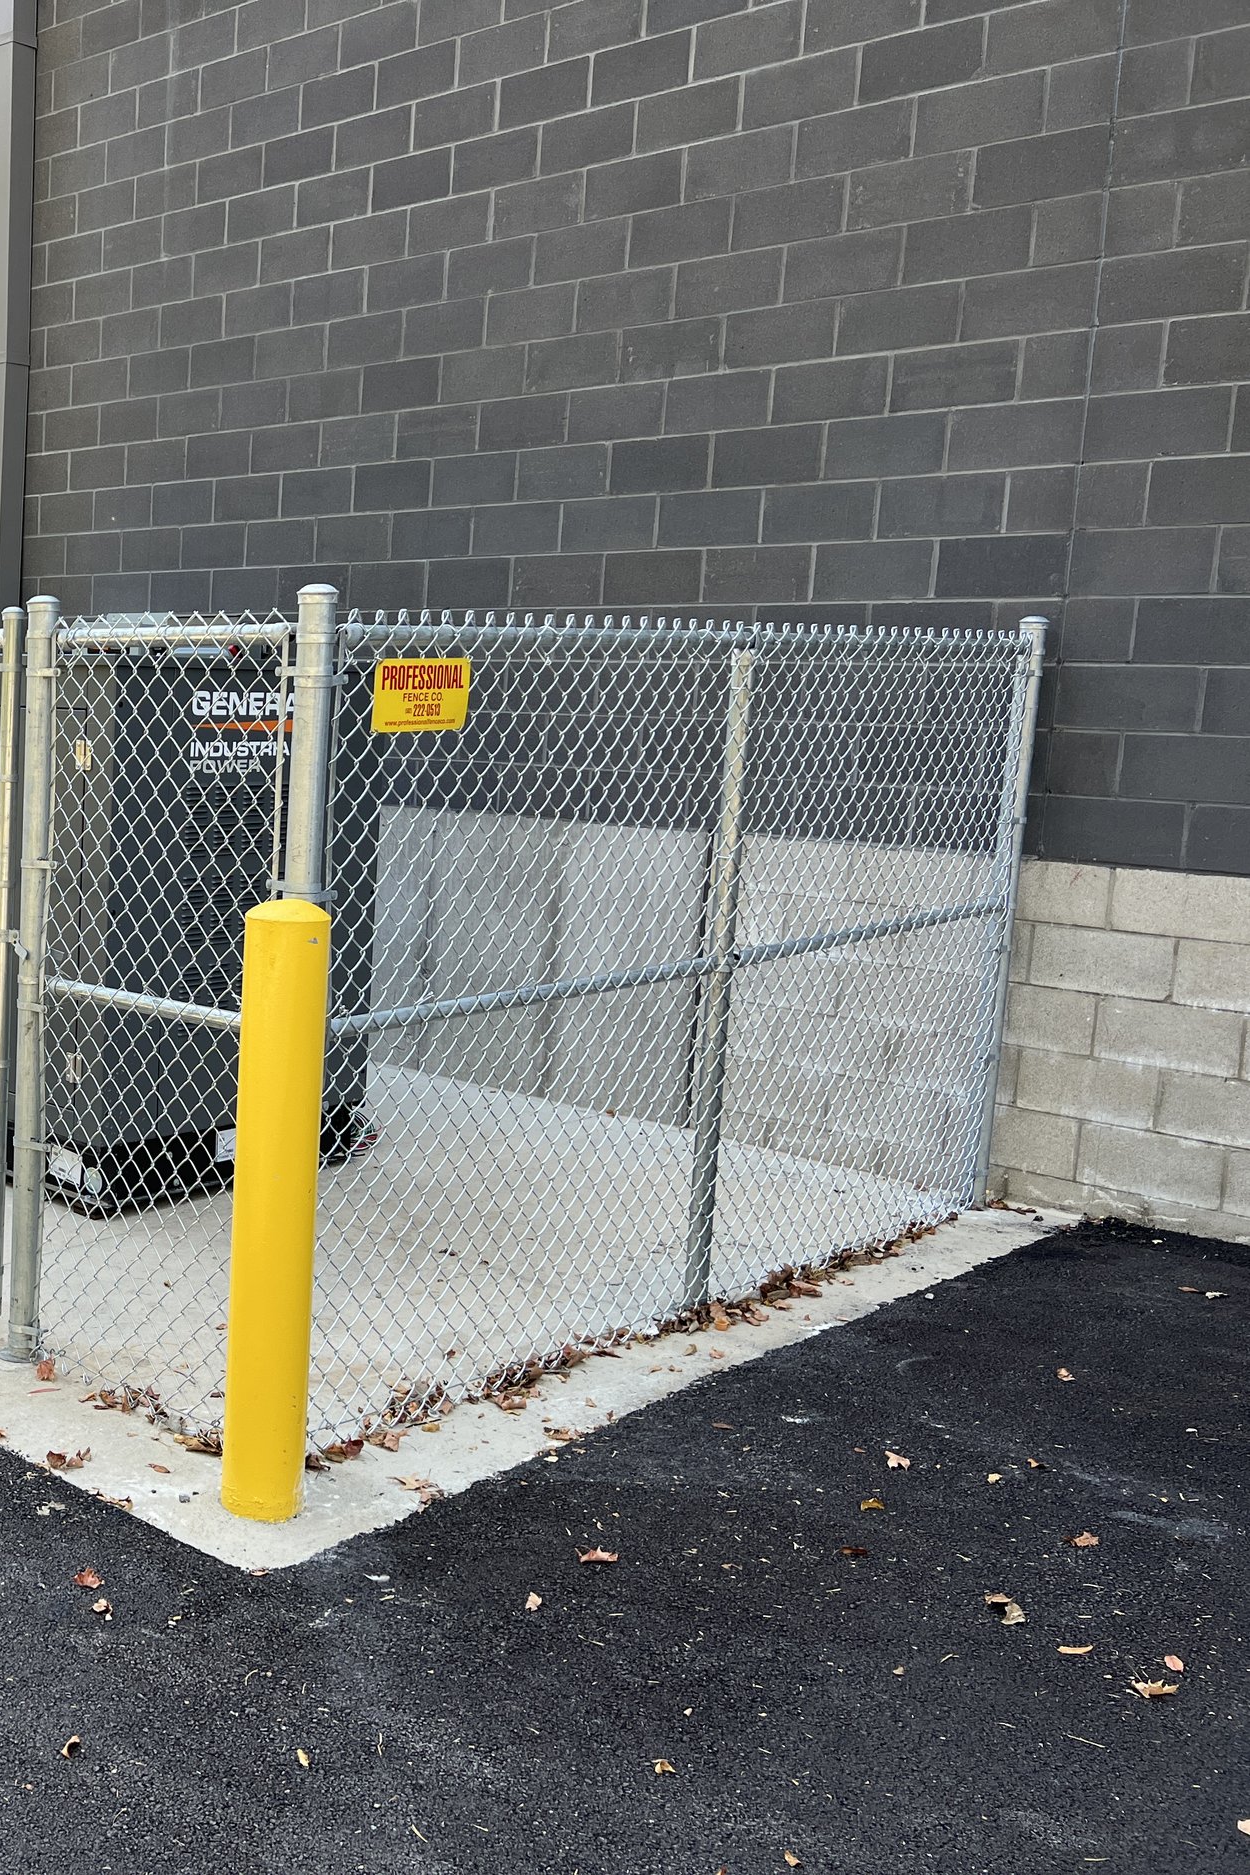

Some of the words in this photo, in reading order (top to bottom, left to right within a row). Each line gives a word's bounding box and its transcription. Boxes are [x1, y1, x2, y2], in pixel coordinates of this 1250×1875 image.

[381, 664, 464, 691] PROFESSIONAL
[191, 690, 295, 716] GENERA
[403, 692, 429, 702] FENCE
[431, 691, 444, 702] CO.
[413, 703, 441, 717] 222-0513
[190, 741, 291, 757] INDUSTRIA
[190, 759, 261, 774] POWER
